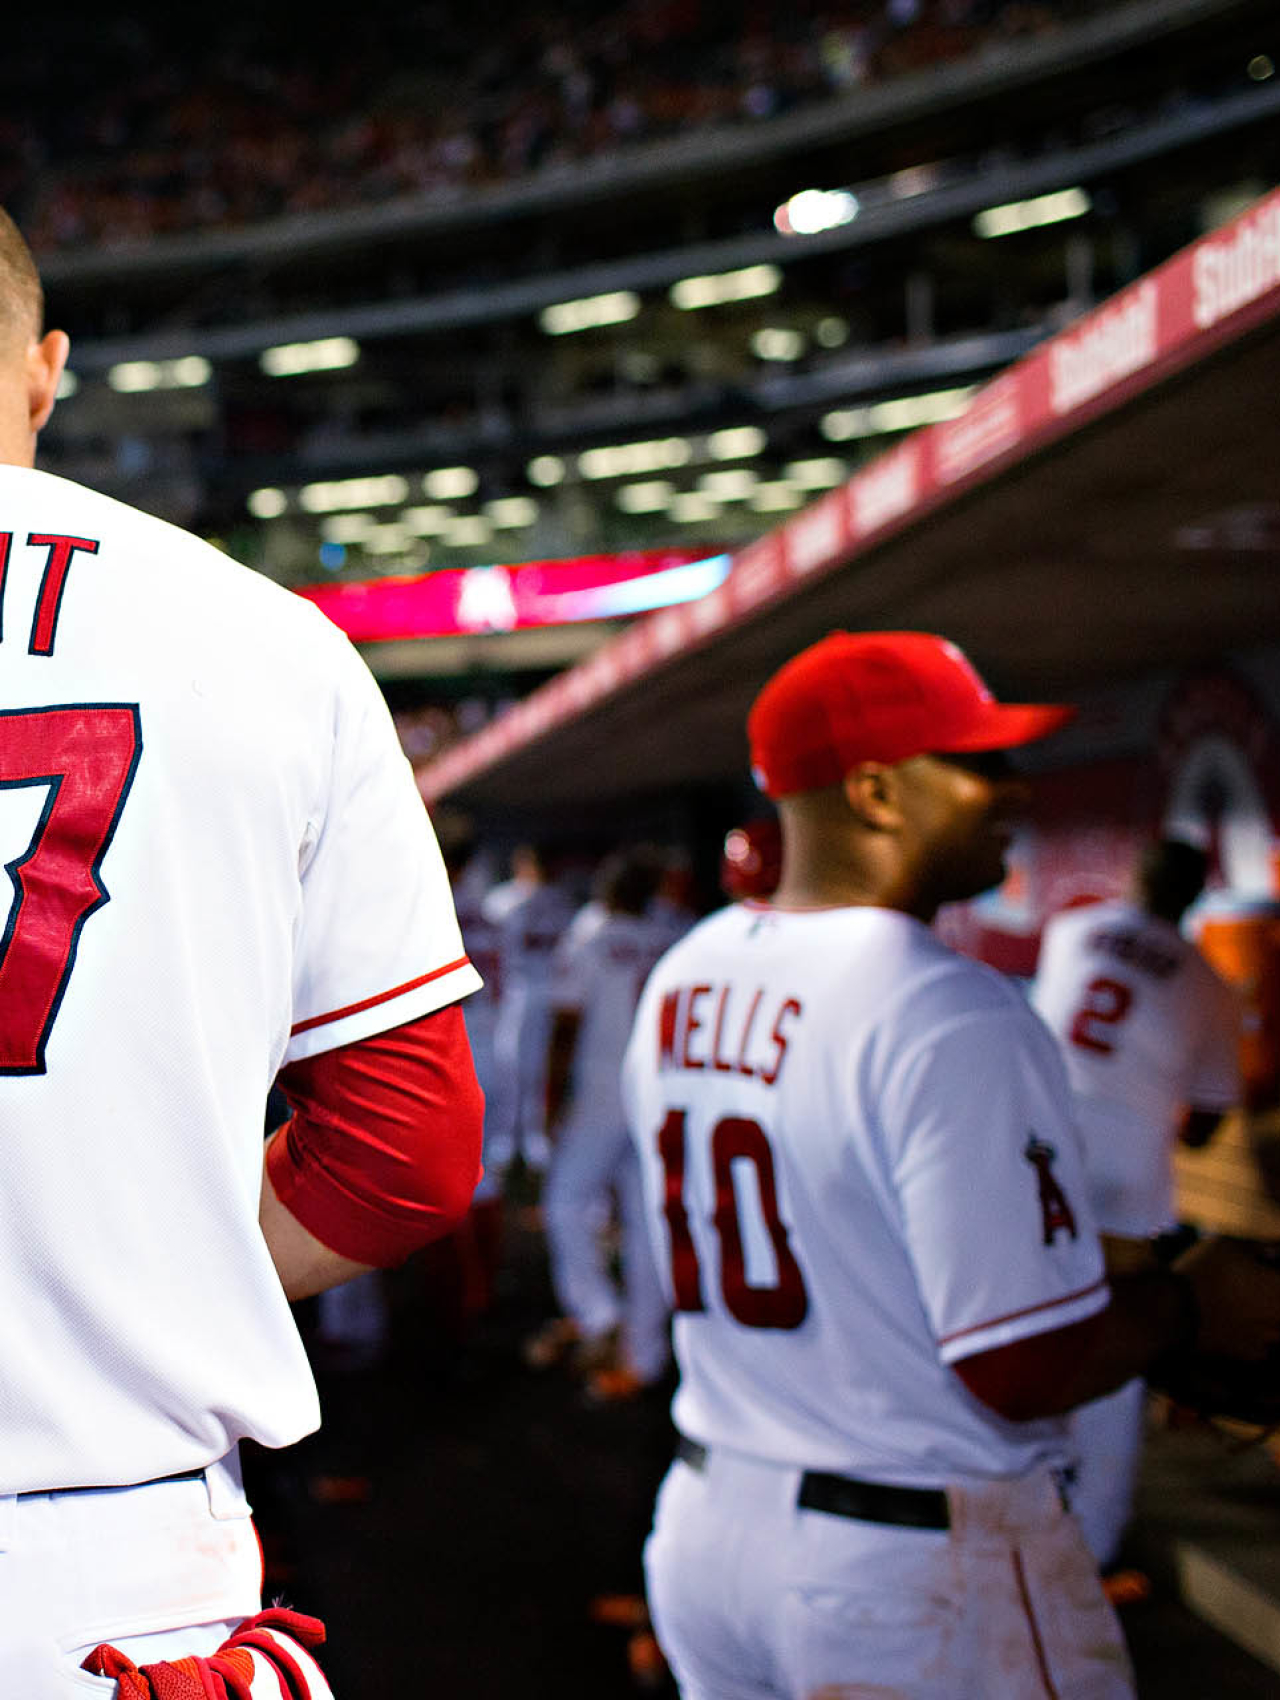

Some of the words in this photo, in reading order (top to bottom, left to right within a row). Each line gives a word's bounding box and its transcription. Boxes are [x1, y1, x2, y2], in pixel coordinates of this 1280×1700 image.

[657, 983, 802, 1086] WELLS
[1069, 977, 1134, 1058] 2
[656, 1109, 809, 1331] 10
